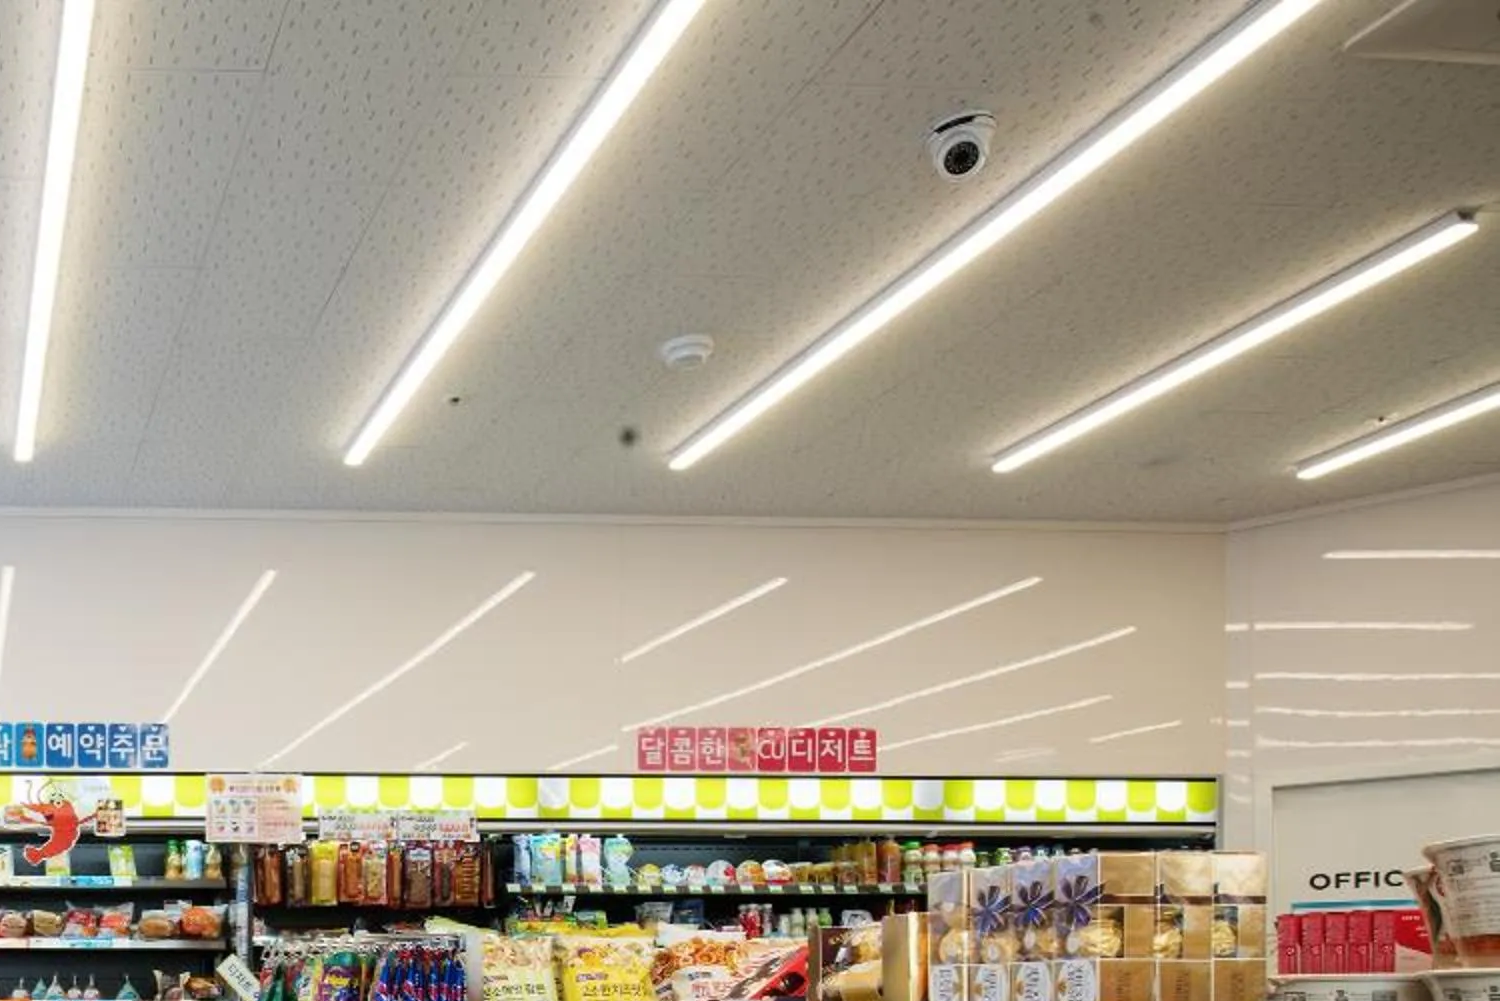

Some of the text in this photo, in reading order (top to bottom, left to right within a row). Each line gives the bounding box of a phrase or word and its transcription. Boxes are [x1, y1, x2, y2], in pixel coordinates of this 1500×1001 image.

[47, 732, 168, 761] 예약주문
[640, 735, 875, 764] 달콤한 CU 디저트
[1309, 869, 1404, 890] OFFIC
